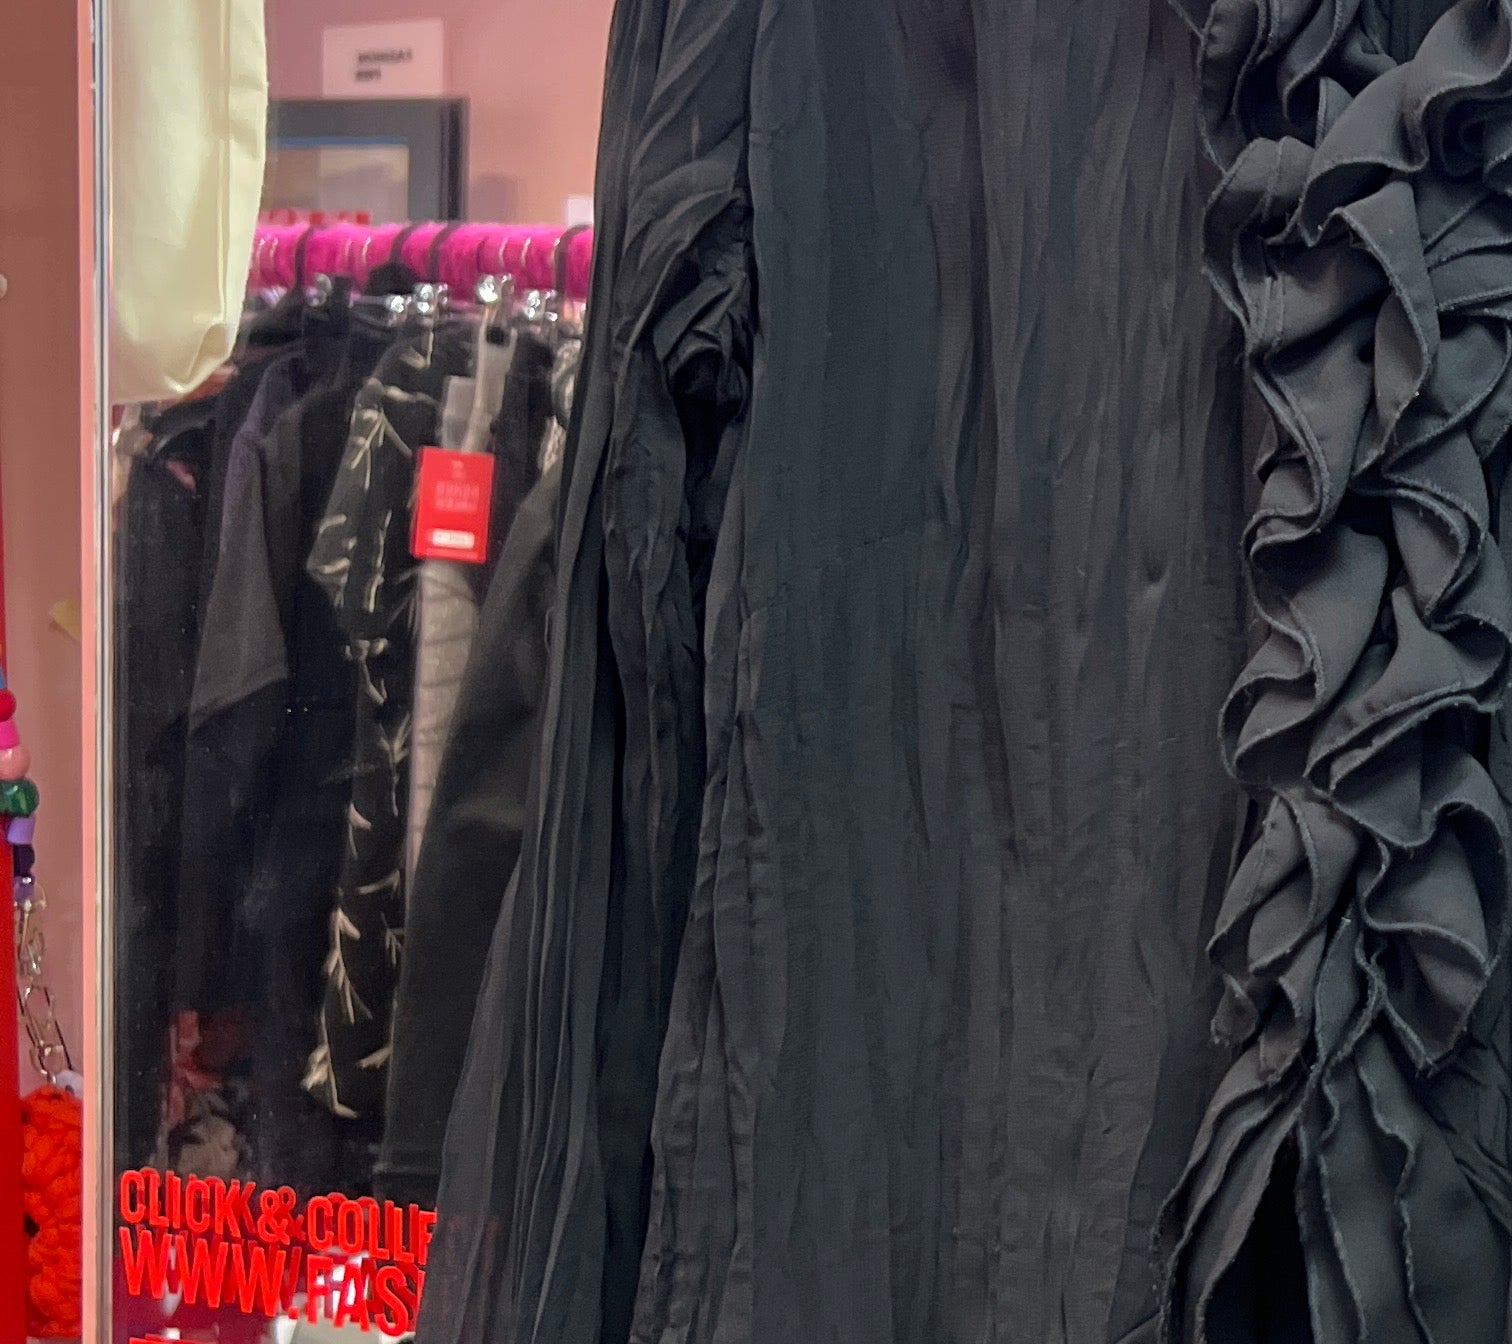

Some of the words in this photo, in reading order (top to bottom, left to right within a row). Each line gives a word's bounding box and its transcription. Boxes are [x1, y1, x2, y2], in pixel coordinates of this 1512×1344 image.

[120, 1169, 243, 1238] CLICK
[256, 1188, 291, 1246] &
[119, 1226, 426, 1338] WWW.FAS
